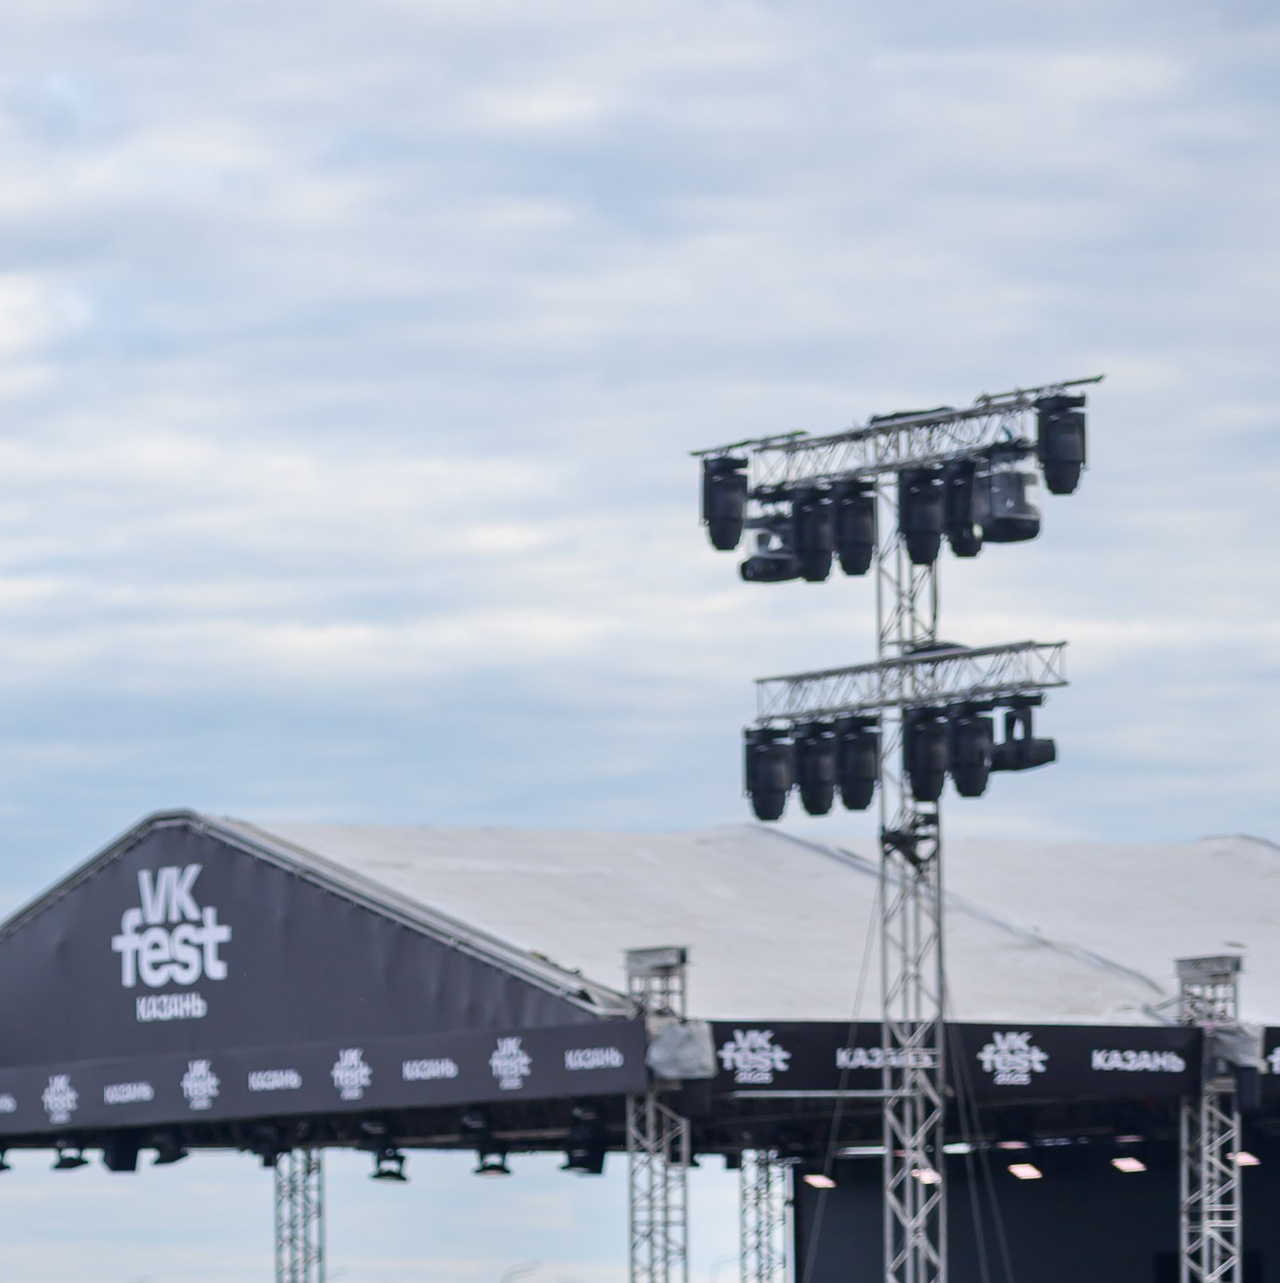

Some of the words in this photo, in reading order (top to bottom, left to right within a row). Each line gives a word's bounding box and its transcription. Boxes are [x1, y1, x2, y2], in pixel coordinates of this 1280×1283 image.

[138, 863, 203, 925] VK
[111, 906, 232, 988] fest
[136, 992, 208, 1022] КАЗАНЬ
[733, 1029, 775, 1050] VK
[993, 1032, 1033, 1050] VK
[717, 1041, 792, 1071] fest
[976, 1043, 1049, 1073] fest
[1091, 1049, 1186, 1072] КАЗАНЬ
